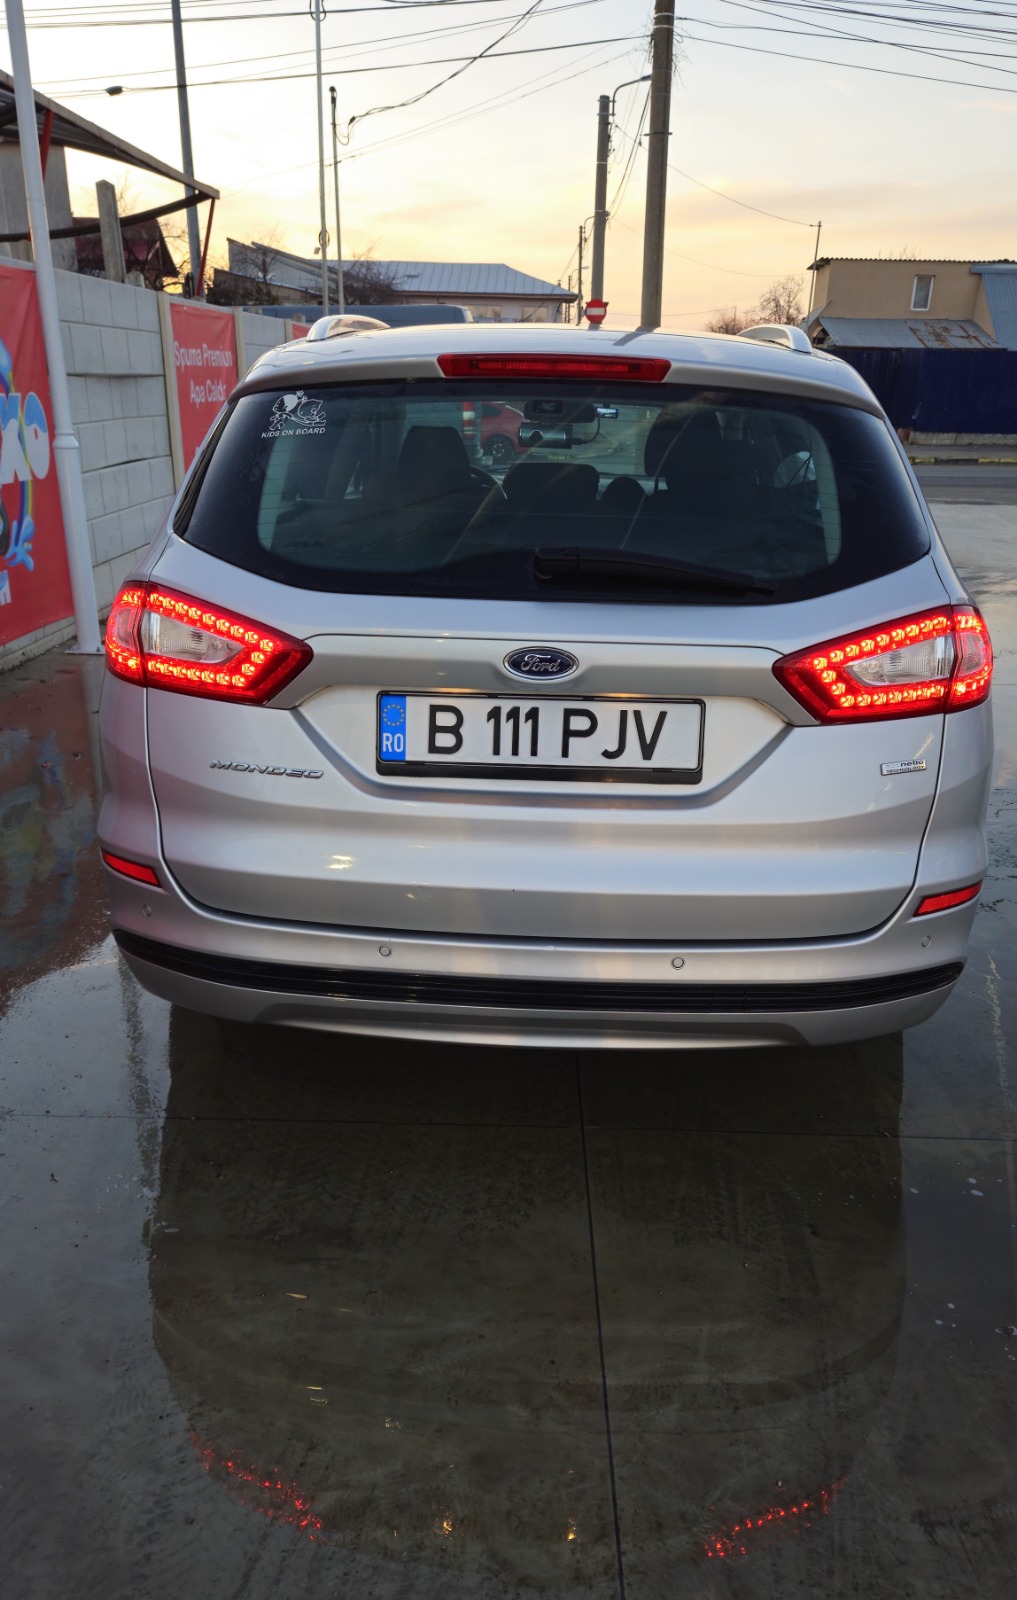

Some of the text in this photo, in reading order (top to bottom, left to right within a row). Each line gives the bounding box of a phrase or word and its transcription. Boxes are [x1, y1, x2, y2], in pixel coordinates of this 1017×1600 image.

[174, 341, 202, 372] Spuma
[190, 380, 205, 408] Apa
[261, 430, 280, 438] KIDS
[295, 427, 326, 435] BOARD
[521, 654, 561, 672] Ford
[383, 732, 404, 753] RO
[428, 704, 668, 761] B 111 PJV
[209, 760, 324, 779] MONDEO
